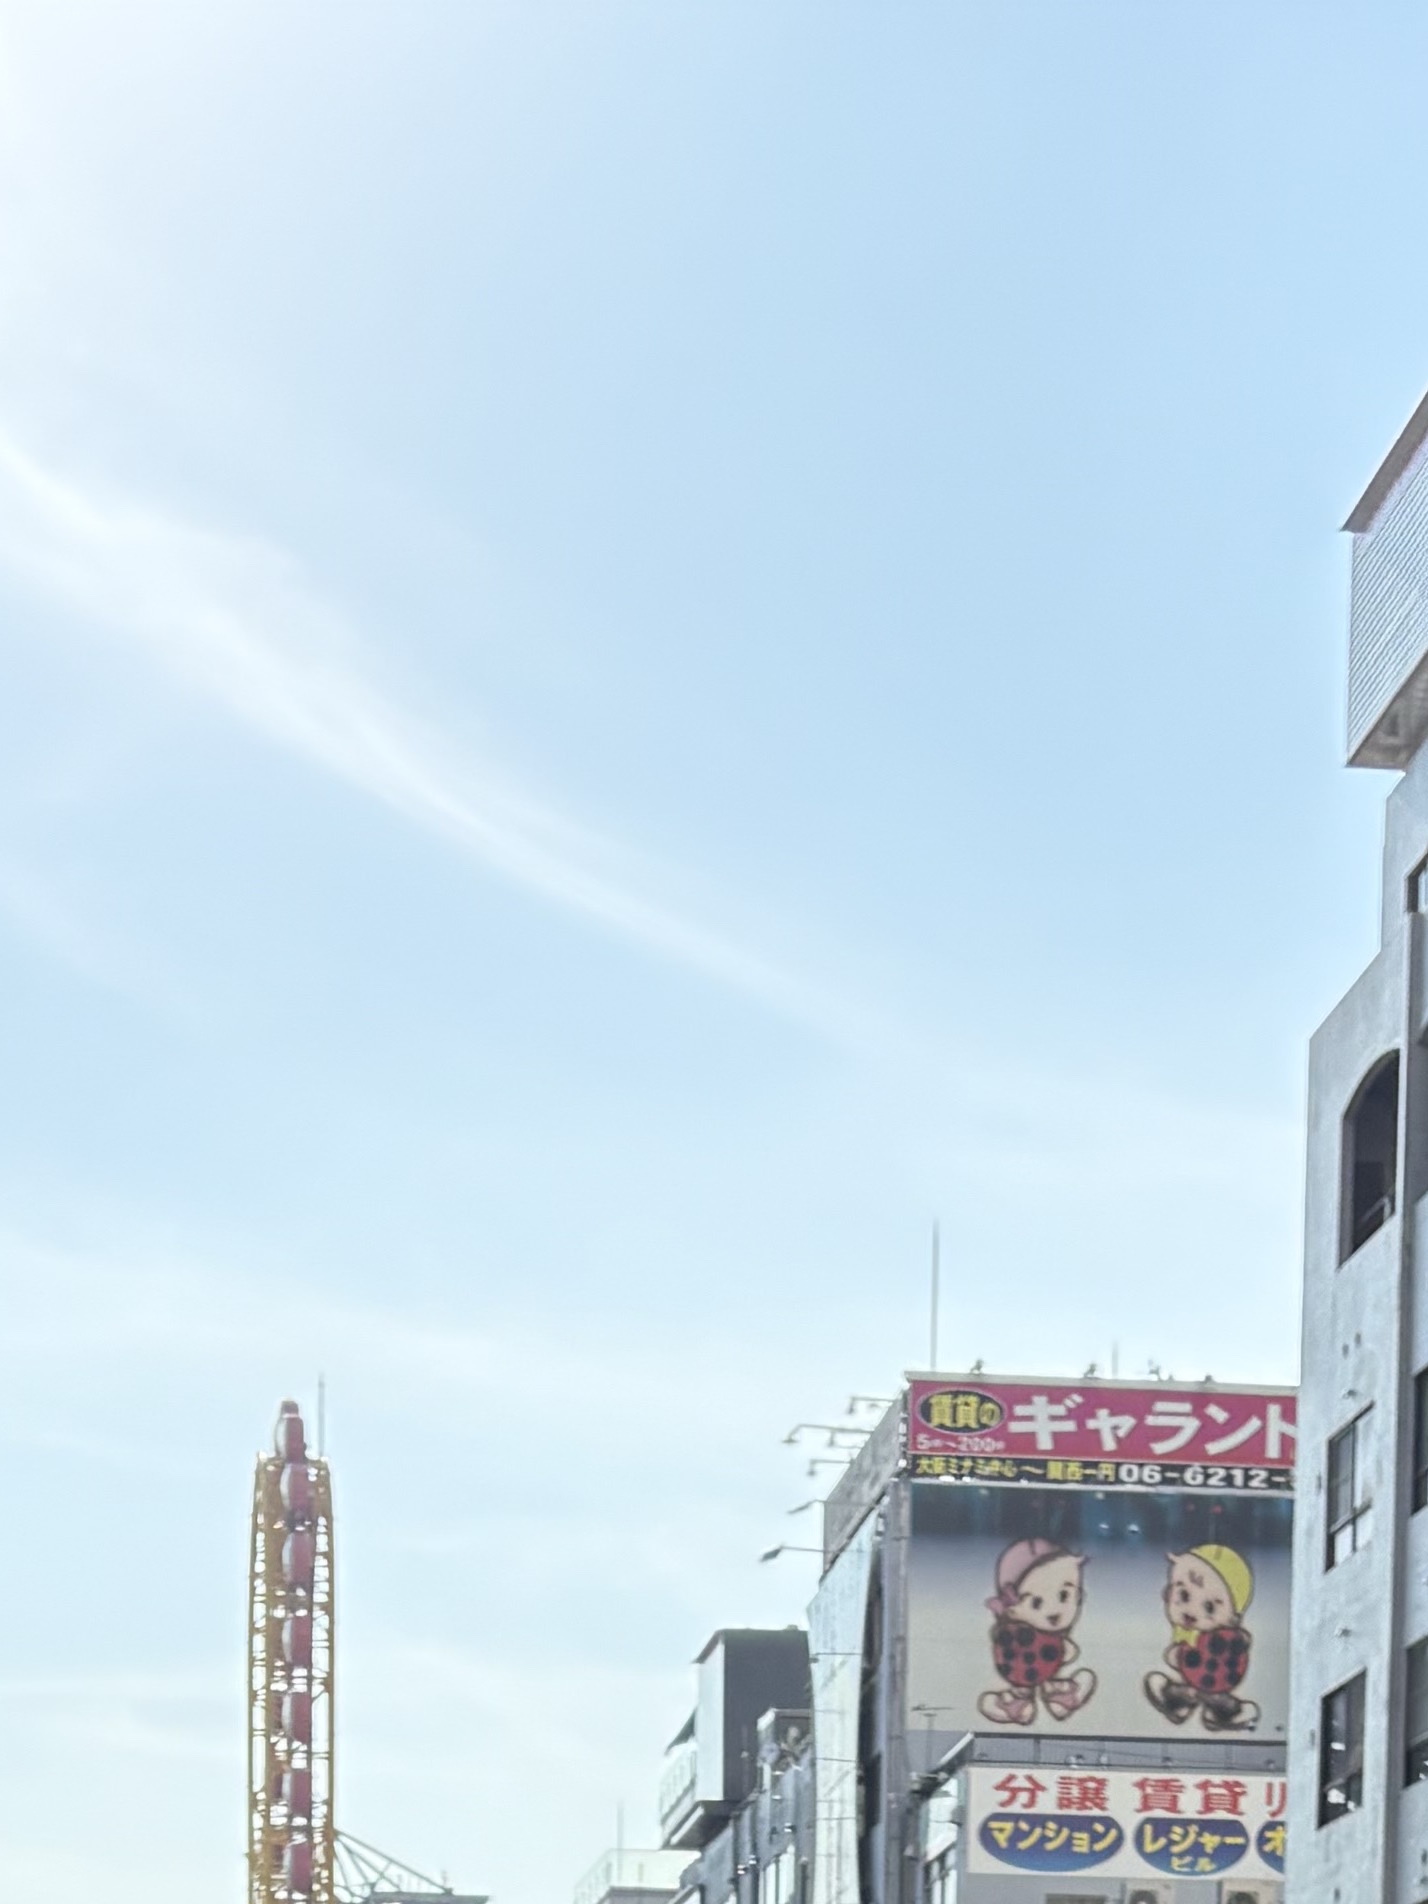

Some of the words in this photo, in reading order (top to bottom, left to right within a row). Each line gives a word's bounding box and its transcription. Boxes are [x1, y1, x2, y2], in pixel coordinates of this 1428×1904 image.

[988, 1821, 1118, 1854] マンション
[1144, 1824, 1246, 1853] レジャー
